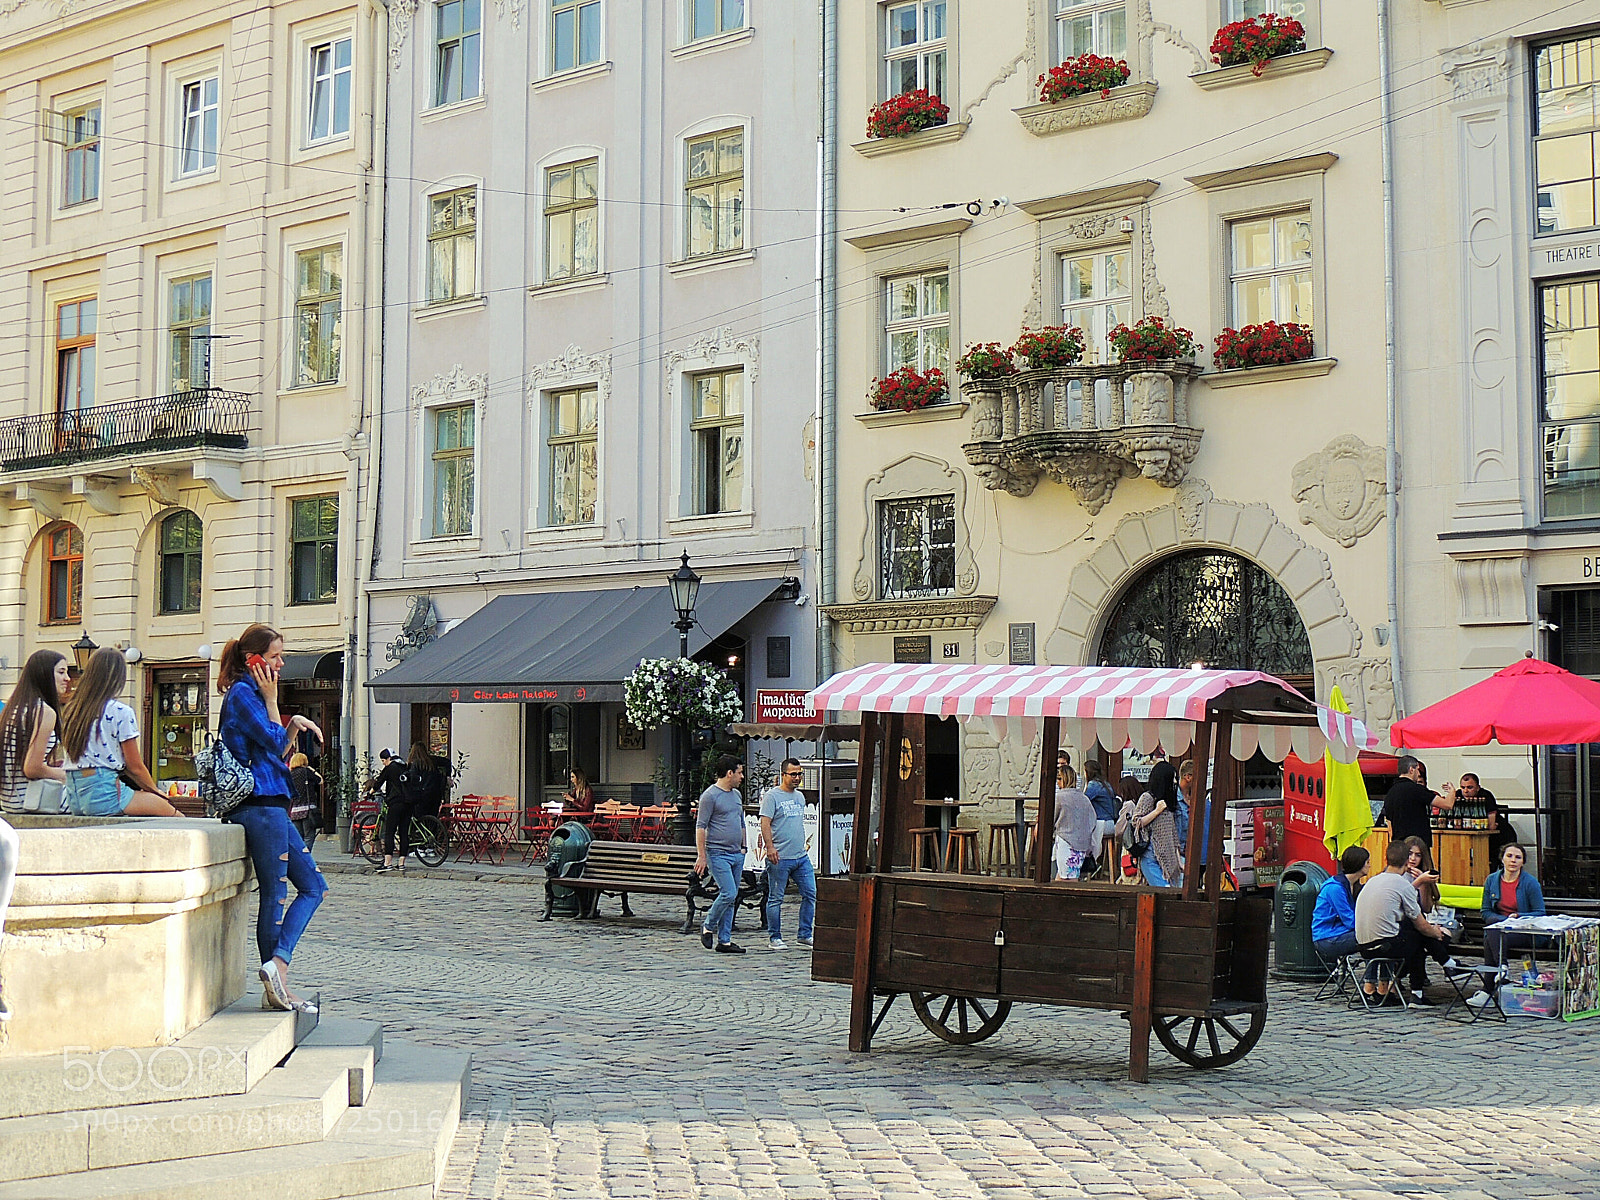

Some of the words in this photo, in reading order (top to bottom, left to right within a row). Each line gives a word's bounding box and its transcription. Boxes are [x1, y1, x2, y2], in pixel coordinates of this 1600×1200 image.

[1546, 246, 1593, 263] THEATRE
[944, 644, 956, 656] 31
[759, 692, 806, 706] італійсь
[763, 707, 817, 720] морозиво
